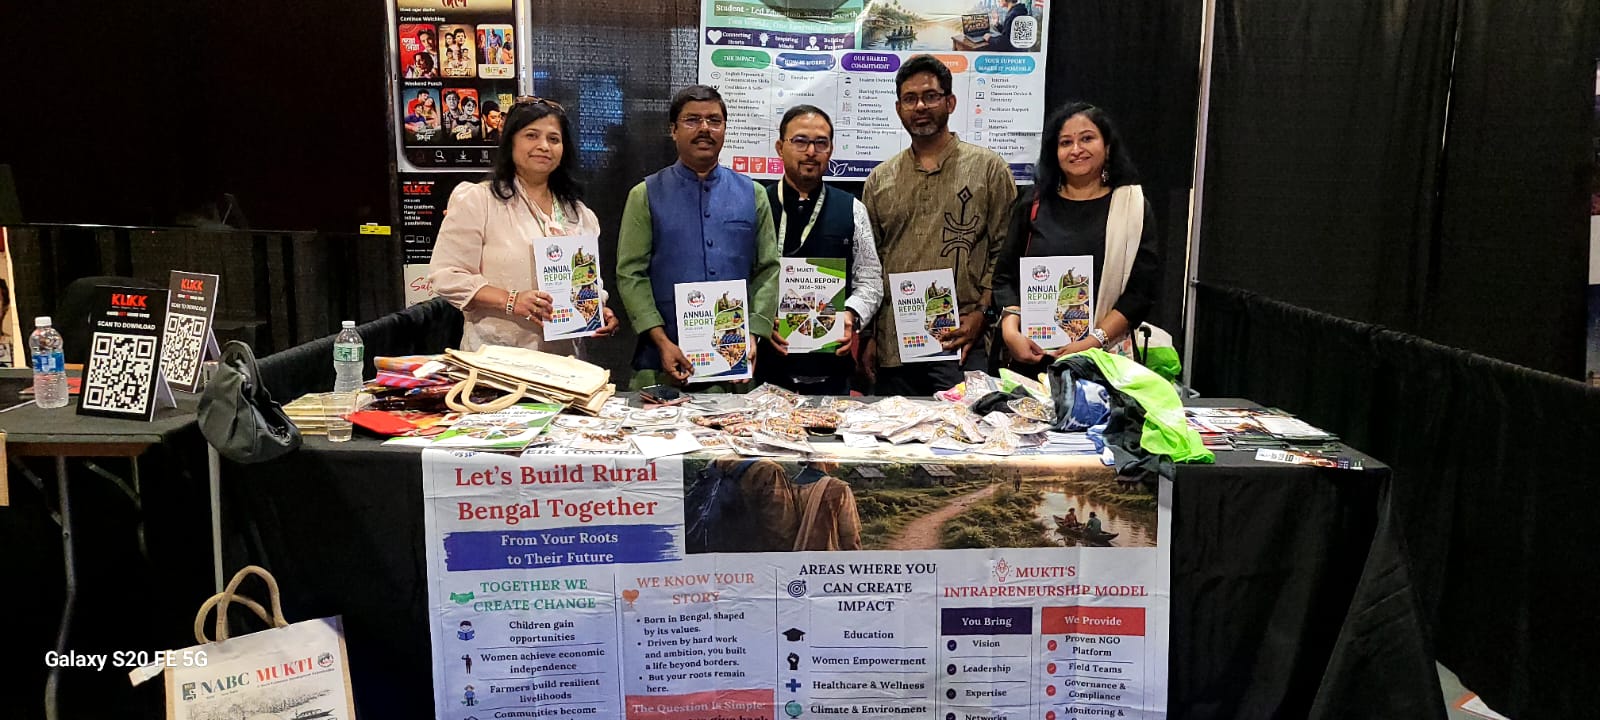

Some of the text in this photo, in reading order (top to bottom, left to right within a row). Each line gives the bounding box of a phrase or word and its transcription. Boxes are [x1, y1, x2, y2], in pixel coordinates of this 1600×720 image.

[716, 4, 744, 13] Student
[722, 31, 751, 40] Connecting
[775, 36, 799, 44] Inspiring
[543, 265, 571, 274] ANNUAL
[544, 273, 571, 282] REPORT
[1027, 285, 1058, 293] ANNUAL
[897, 297, 925, 306] ANNUAL
[1027, 292, 1057, 301] REPORT
[898, 304, 925, 313] REPORT
[683, 310, 713, 319] ANNUAL
[122, 322, 156, 330] DOWNLOAD
[683, 318, 715, 327] REPORT
[454, 462, 658, 487] Let's Build Rural
[457, 496, 659, 525] Bengal Together
[501, 532, 619, 547] From Your Roots
[507, 552, 614, 565] to Their Future
[799, 563, 937, 576] AREAS WHERE YOU
[1015, 566, 1076, 579] MUKTI'S
[479, 578, 588, 593] TOGETHER WE
[636, 573, 755, 589] WE KNOW YOUR
[823, 582, 912, 593] CAN CREATE
[944, 585, 1149, 598] INTRAPRENEURSHIP MODEL
[672, 591, 720, 605] STORY
[473, 597, 597, 613] CREATE CHANGE
[838, 601, 895, 612] IMPACT
[644, 612, 745, 624] Born in Bengal, shaped
[961, 616, 1013, 628] You Bring
[1064, 616, 1122, 626] We Provide
[509, 619, 574, 630] Children gain
[644, 626, 701, 636] by its values.
[843, 630, 894, 639] Education
[509, 633, 576, 644] opportunities
[647, 635, 738, 647] Driven by hard work
[972, 639, 1001, 648] Vision
[1065, 635, 1121, 645] Proven NGO
[480, 648, 605, 662] Women achieve economic
[645, 646, 746, 659] and ambition, you built
[1071, 646, 1112, 657] Platform
[652, 661, 668, 670] life
[669, 659, 701, 671] beyond
[703, 658, 740, 667] borders.
[811, 656, 926, 668] Women Empowerment
[255, 657, 313, 683] MUKTI
[509, 663, 577, 676] independence
[962, 664, 1012, 674] Leadership
[1068, 663, 1122, 674] Field Teams
[648, 670, 745, 683] But your roots remain
[200, 672, 250, 695] NABC
[490, 679, 600, 694] Farmers build resilient
[646, 684, 669, 693] here.
[812, 680, 925, 690] Healthcare & Wellness
[1064, 679, 1126, 690] Governance &
[519, 692, 572, 703] livelihoods
[965, 688, 1008, 698] Expertise
[1068, 690, 1121, 701] Compliance
[494, 706, 597, 720] Communities become
[632, 704, 655, 713] The
[656, 702, 708, 715] Question
[810, 705, 927, 714] Climate & Environment
[1065, 706, 1125, 719] Monitoring &
